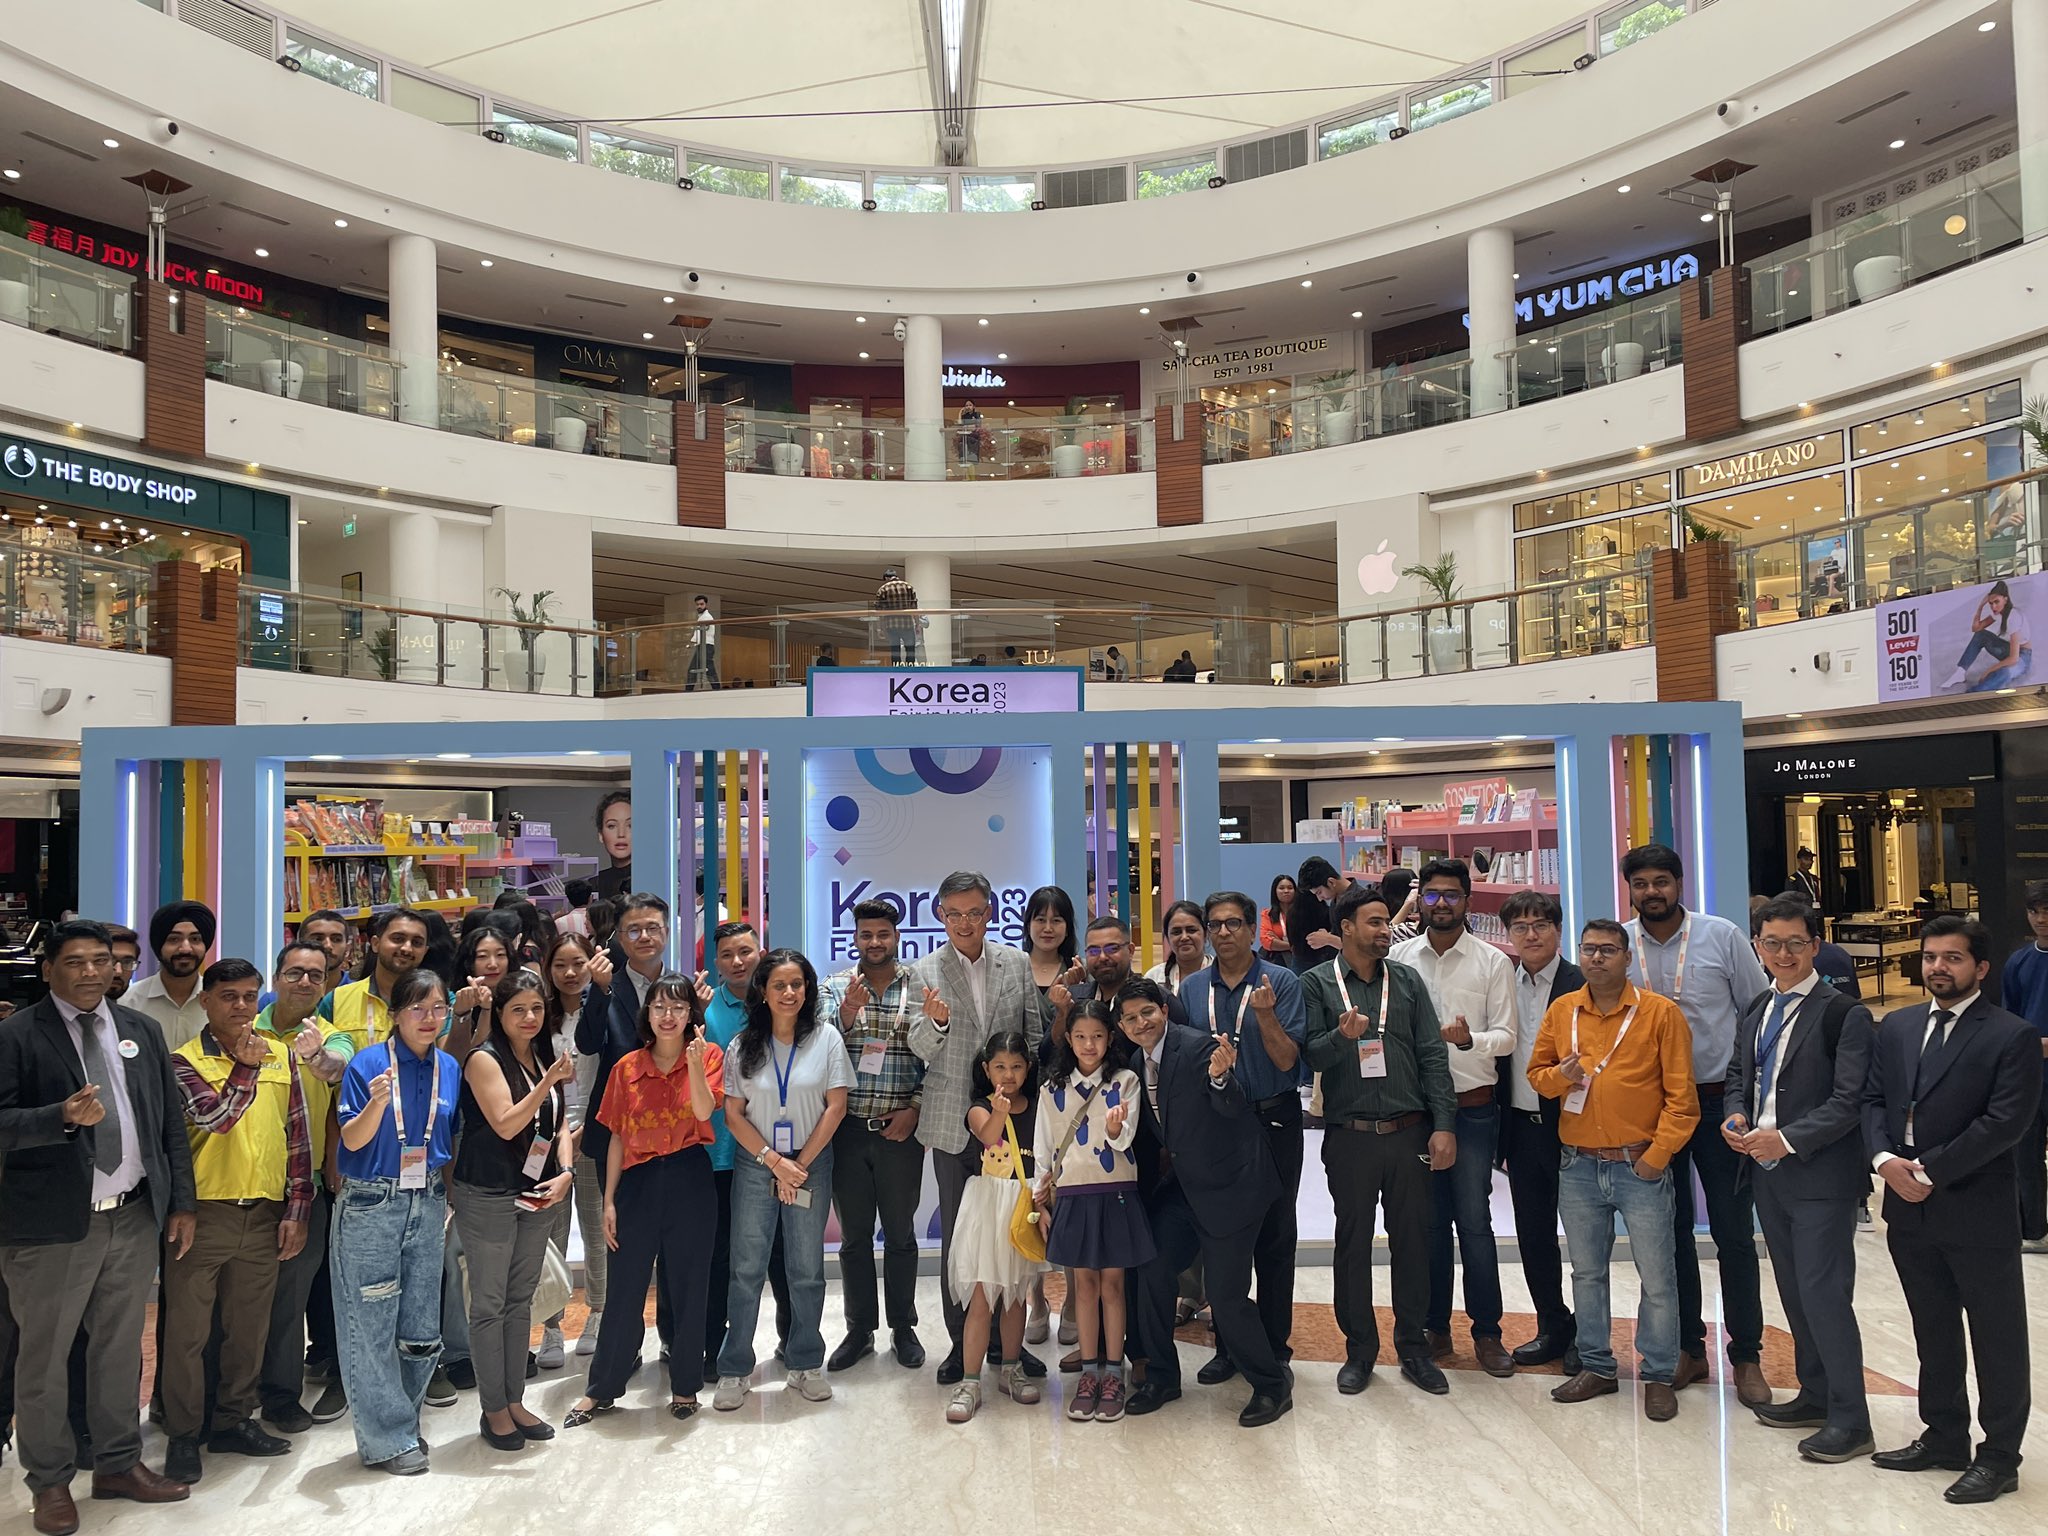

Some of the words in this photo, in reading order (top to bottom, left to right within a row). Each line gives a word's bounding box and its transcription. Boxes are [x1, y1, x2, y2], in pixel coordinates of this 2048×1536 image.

[101, 243, 139, 268] JOY
[205, 273, 263, 303] MOON
[1536, 275, 1612, 317] YUM
[1617, 253, 1699, 296] CHA
[563, 344, 619, 370] OMA
[1162, 353, 1220, 371] SA-CHA
[1223, 351, 1250, 363] TEA
[1254, 338, 1328, 358] BOUTIQUE
[1247, 362, 1274, 375] 1981
[42, 457, 83, 483] THE
[89, 468, 142, 494] BODY
[146, 480, 197, 505] SHOP
[1699, 442, 1815, 485] DAMILANO
[889, 678, 990, 703] Korea
[1795, 759, 1856, 771] MALONE
[832, 881, 999, 928] Kor
